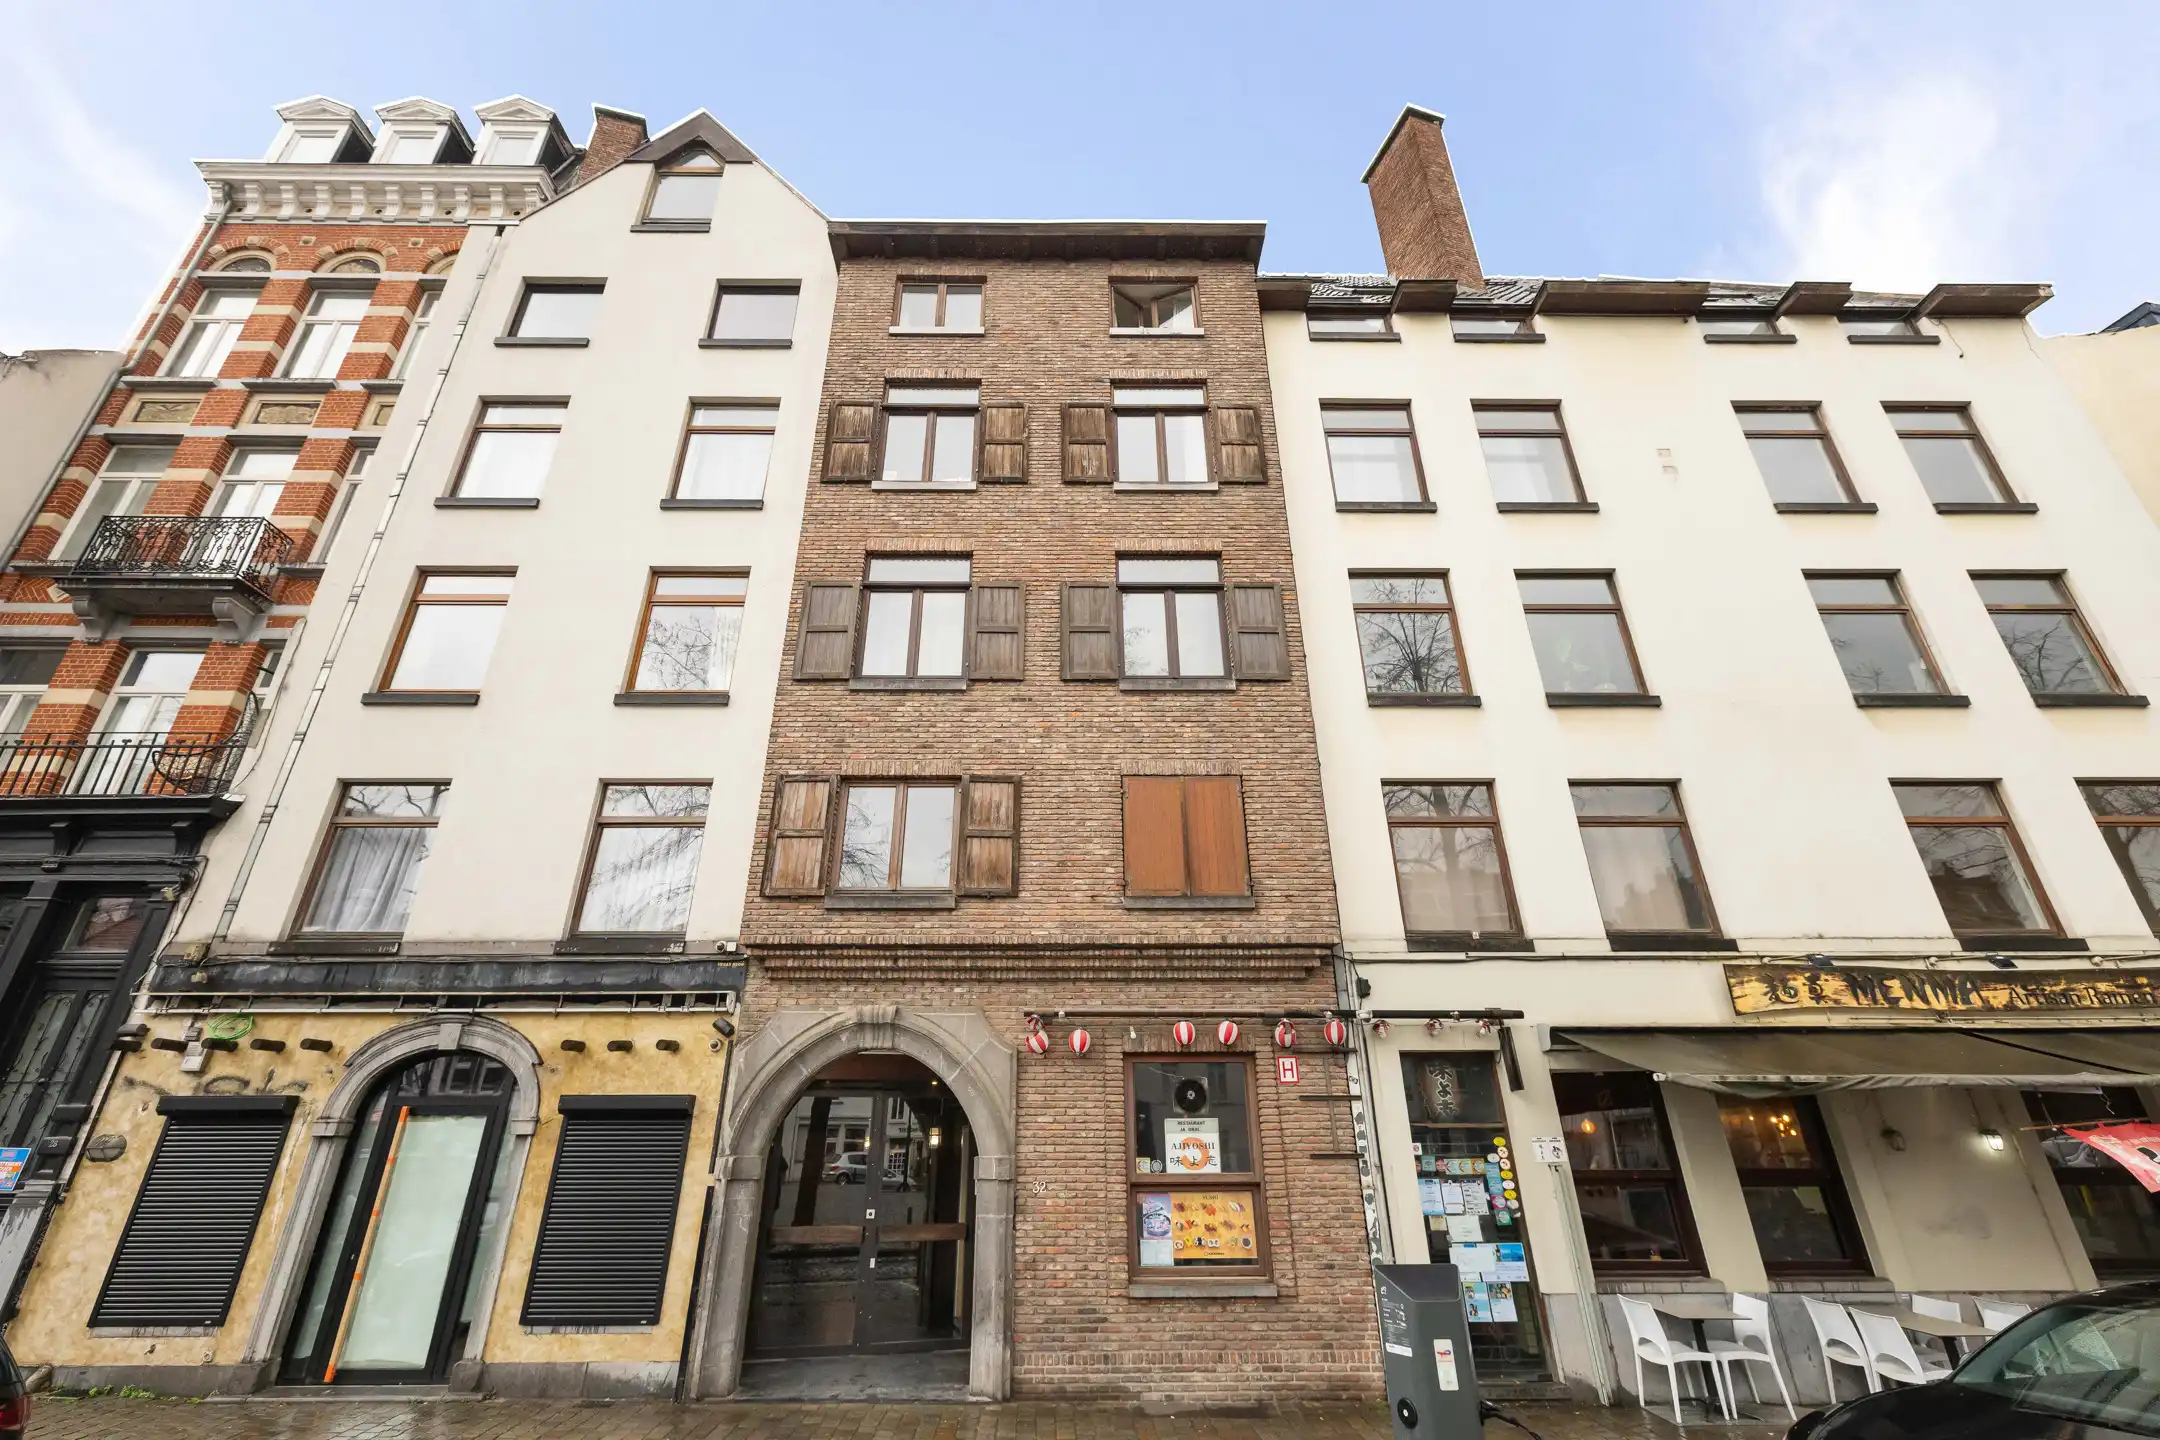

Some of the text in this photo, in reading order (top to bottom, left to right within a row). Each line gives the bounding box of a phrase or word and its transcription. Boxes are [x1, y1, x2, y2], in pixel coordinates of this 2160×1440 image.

[1843, 971, 1985, 1006] MENMA
[2009, 985, 2157, 1006] Artisan Ramen
[1281, 1061, 1295, 1079] H
[1171, 1142, 1215, 1150] AJIYOSHI
[1032, 1181, 1046, 1193] 32
